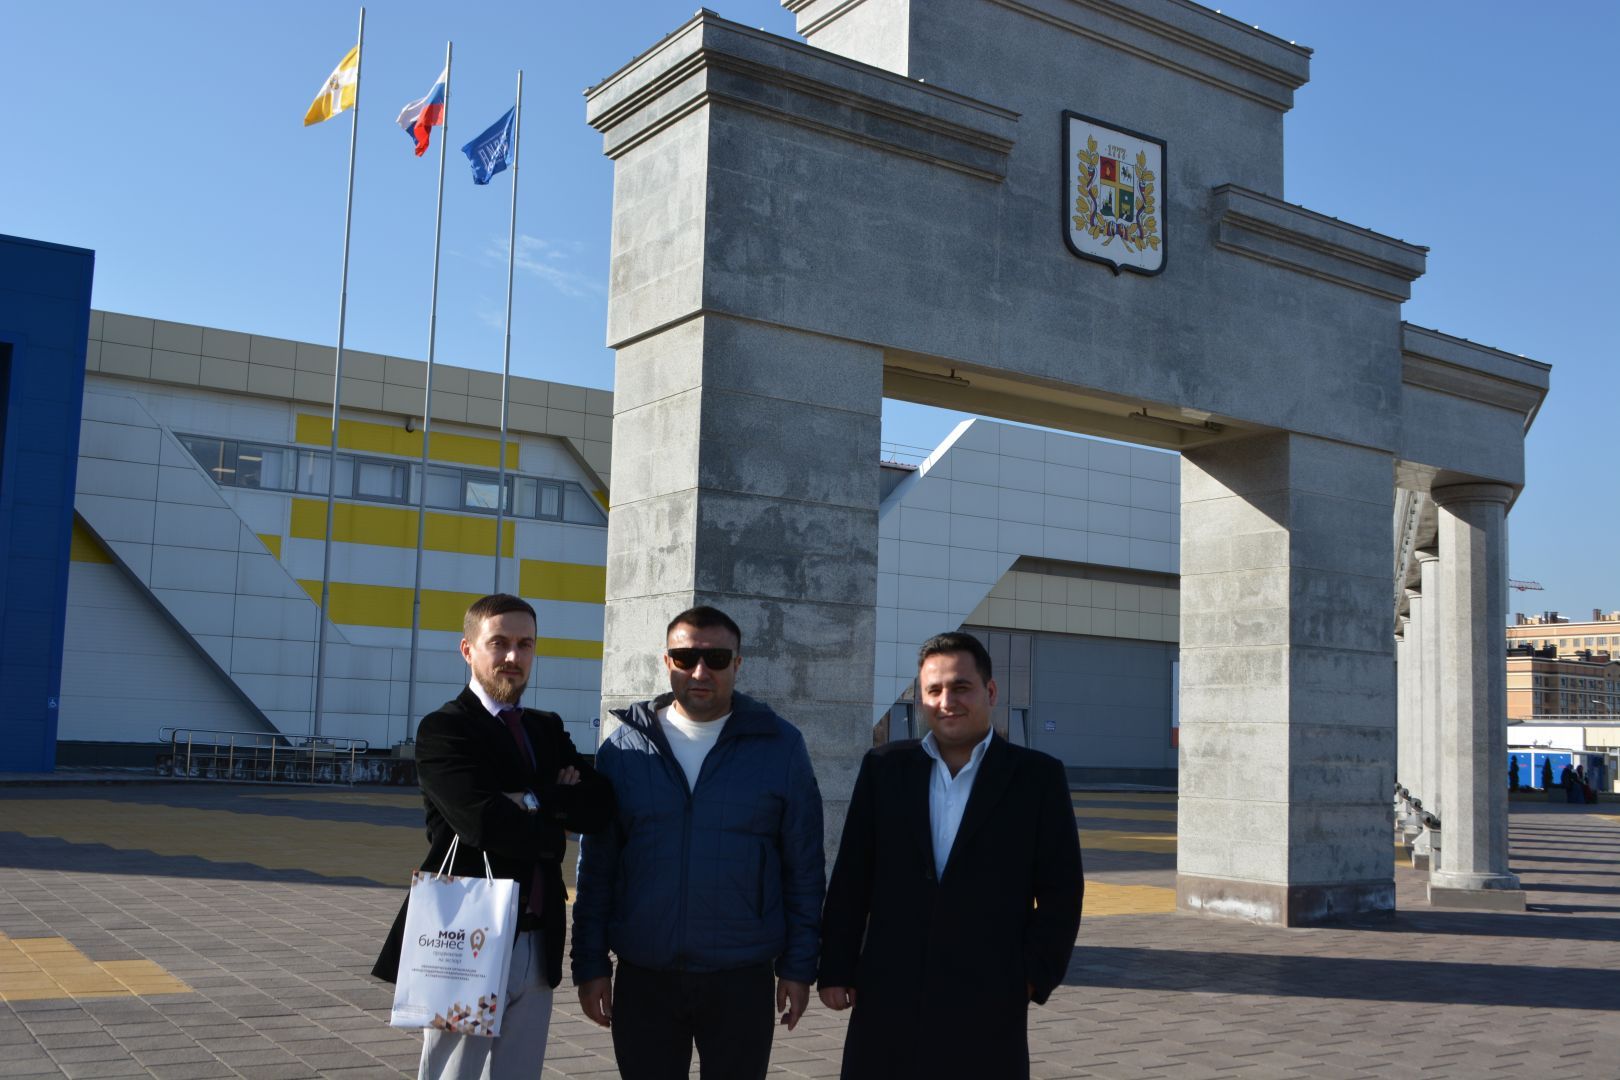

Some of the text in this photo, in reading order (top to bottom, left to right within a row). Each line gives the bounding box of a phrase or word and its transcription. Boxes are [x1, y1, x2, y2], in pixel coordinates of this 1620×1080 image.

[1107, 144, 1127, 161] 1777
[418, 934, 465, 950] бизнес
[438, 929, 466, 941] мой
